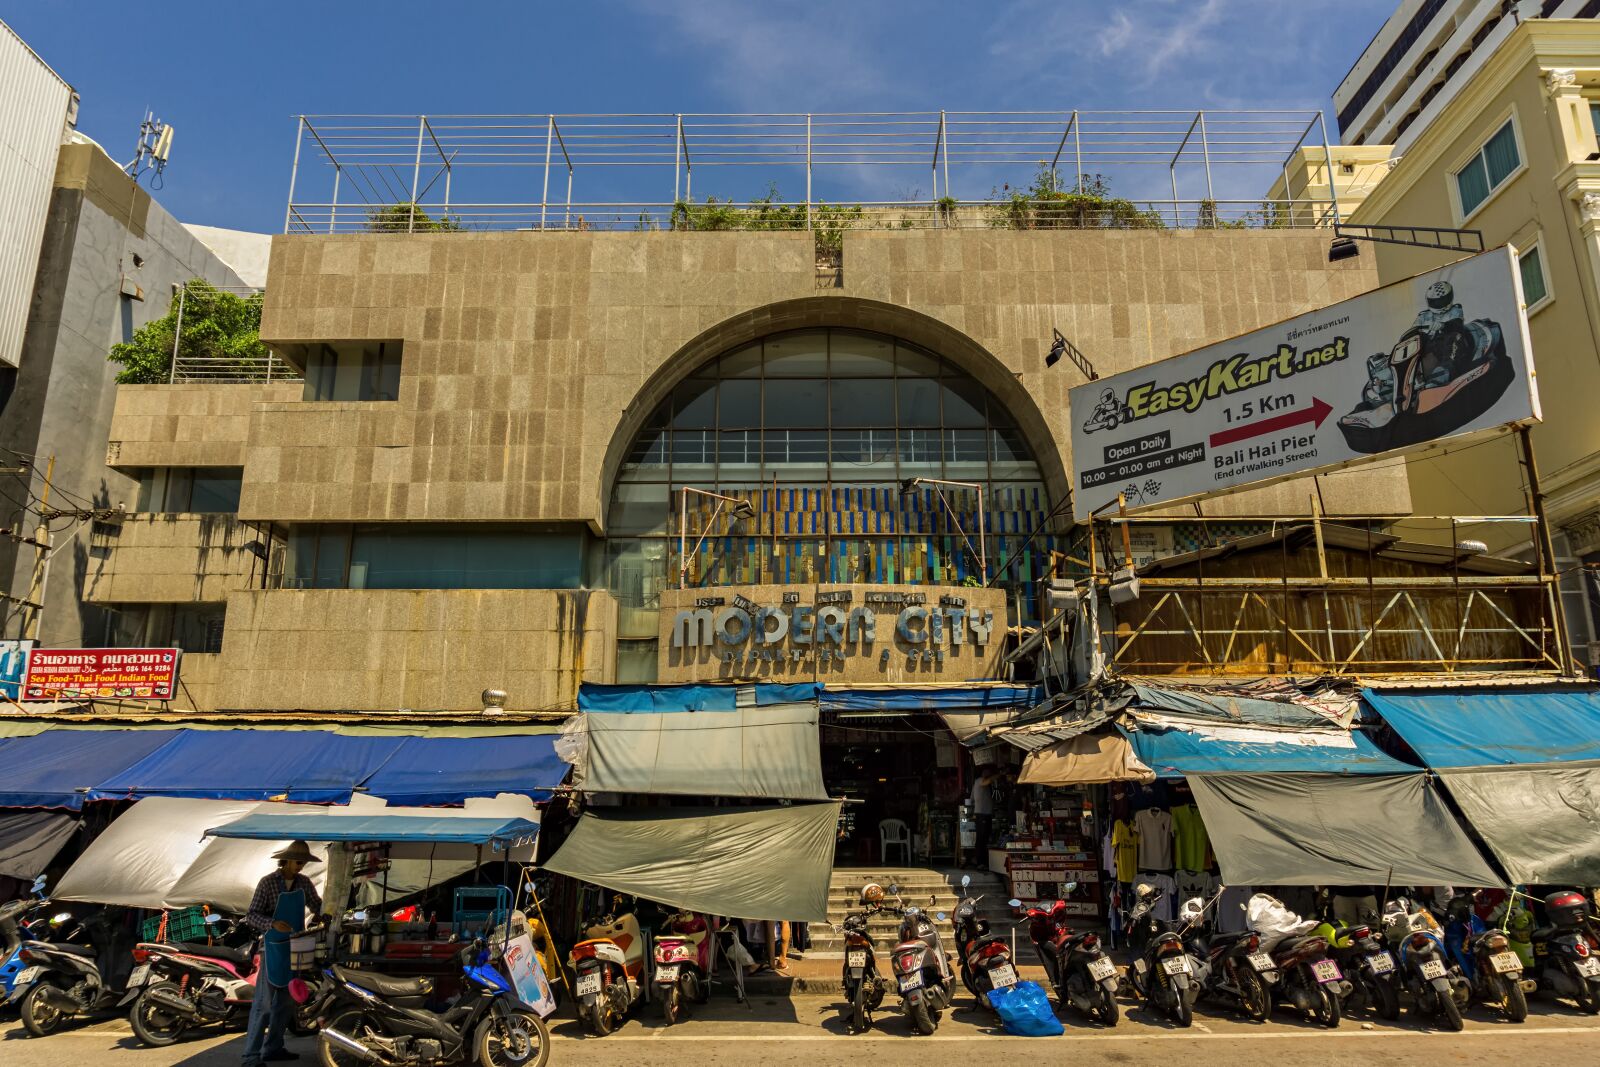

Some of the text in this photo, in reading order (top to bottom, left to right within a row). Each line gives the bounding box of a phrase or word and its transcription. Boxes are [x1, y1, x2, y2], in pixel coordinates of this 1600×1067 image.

[1127, 337, 1349, 419] EasyKart.net
[1223, 393, 1295, 422] 1.5 Km
[1108, 436, 1167, 459] Open Daily
[1214, 434, 1316, 468] Bali Hai Pier
[1083, 471, 1106, 484] 10.00
[1120, 462, 1143, 476] 01.00
[1147, 459, 1160, 468] am
[1165, 455, 1174, 463] at
[1178, 447, 1203, 460] Night
[1214, 448, 1318, 481] (End of Walking Street)
[673, 605, 993, 647] MODERN CITY
[33, 653, 97, 665] ร้านอาหาร
[31, 674, 45, 682] Sea
[95, 674, 116, 682] Food
[148, 673, 169, 681] Food
